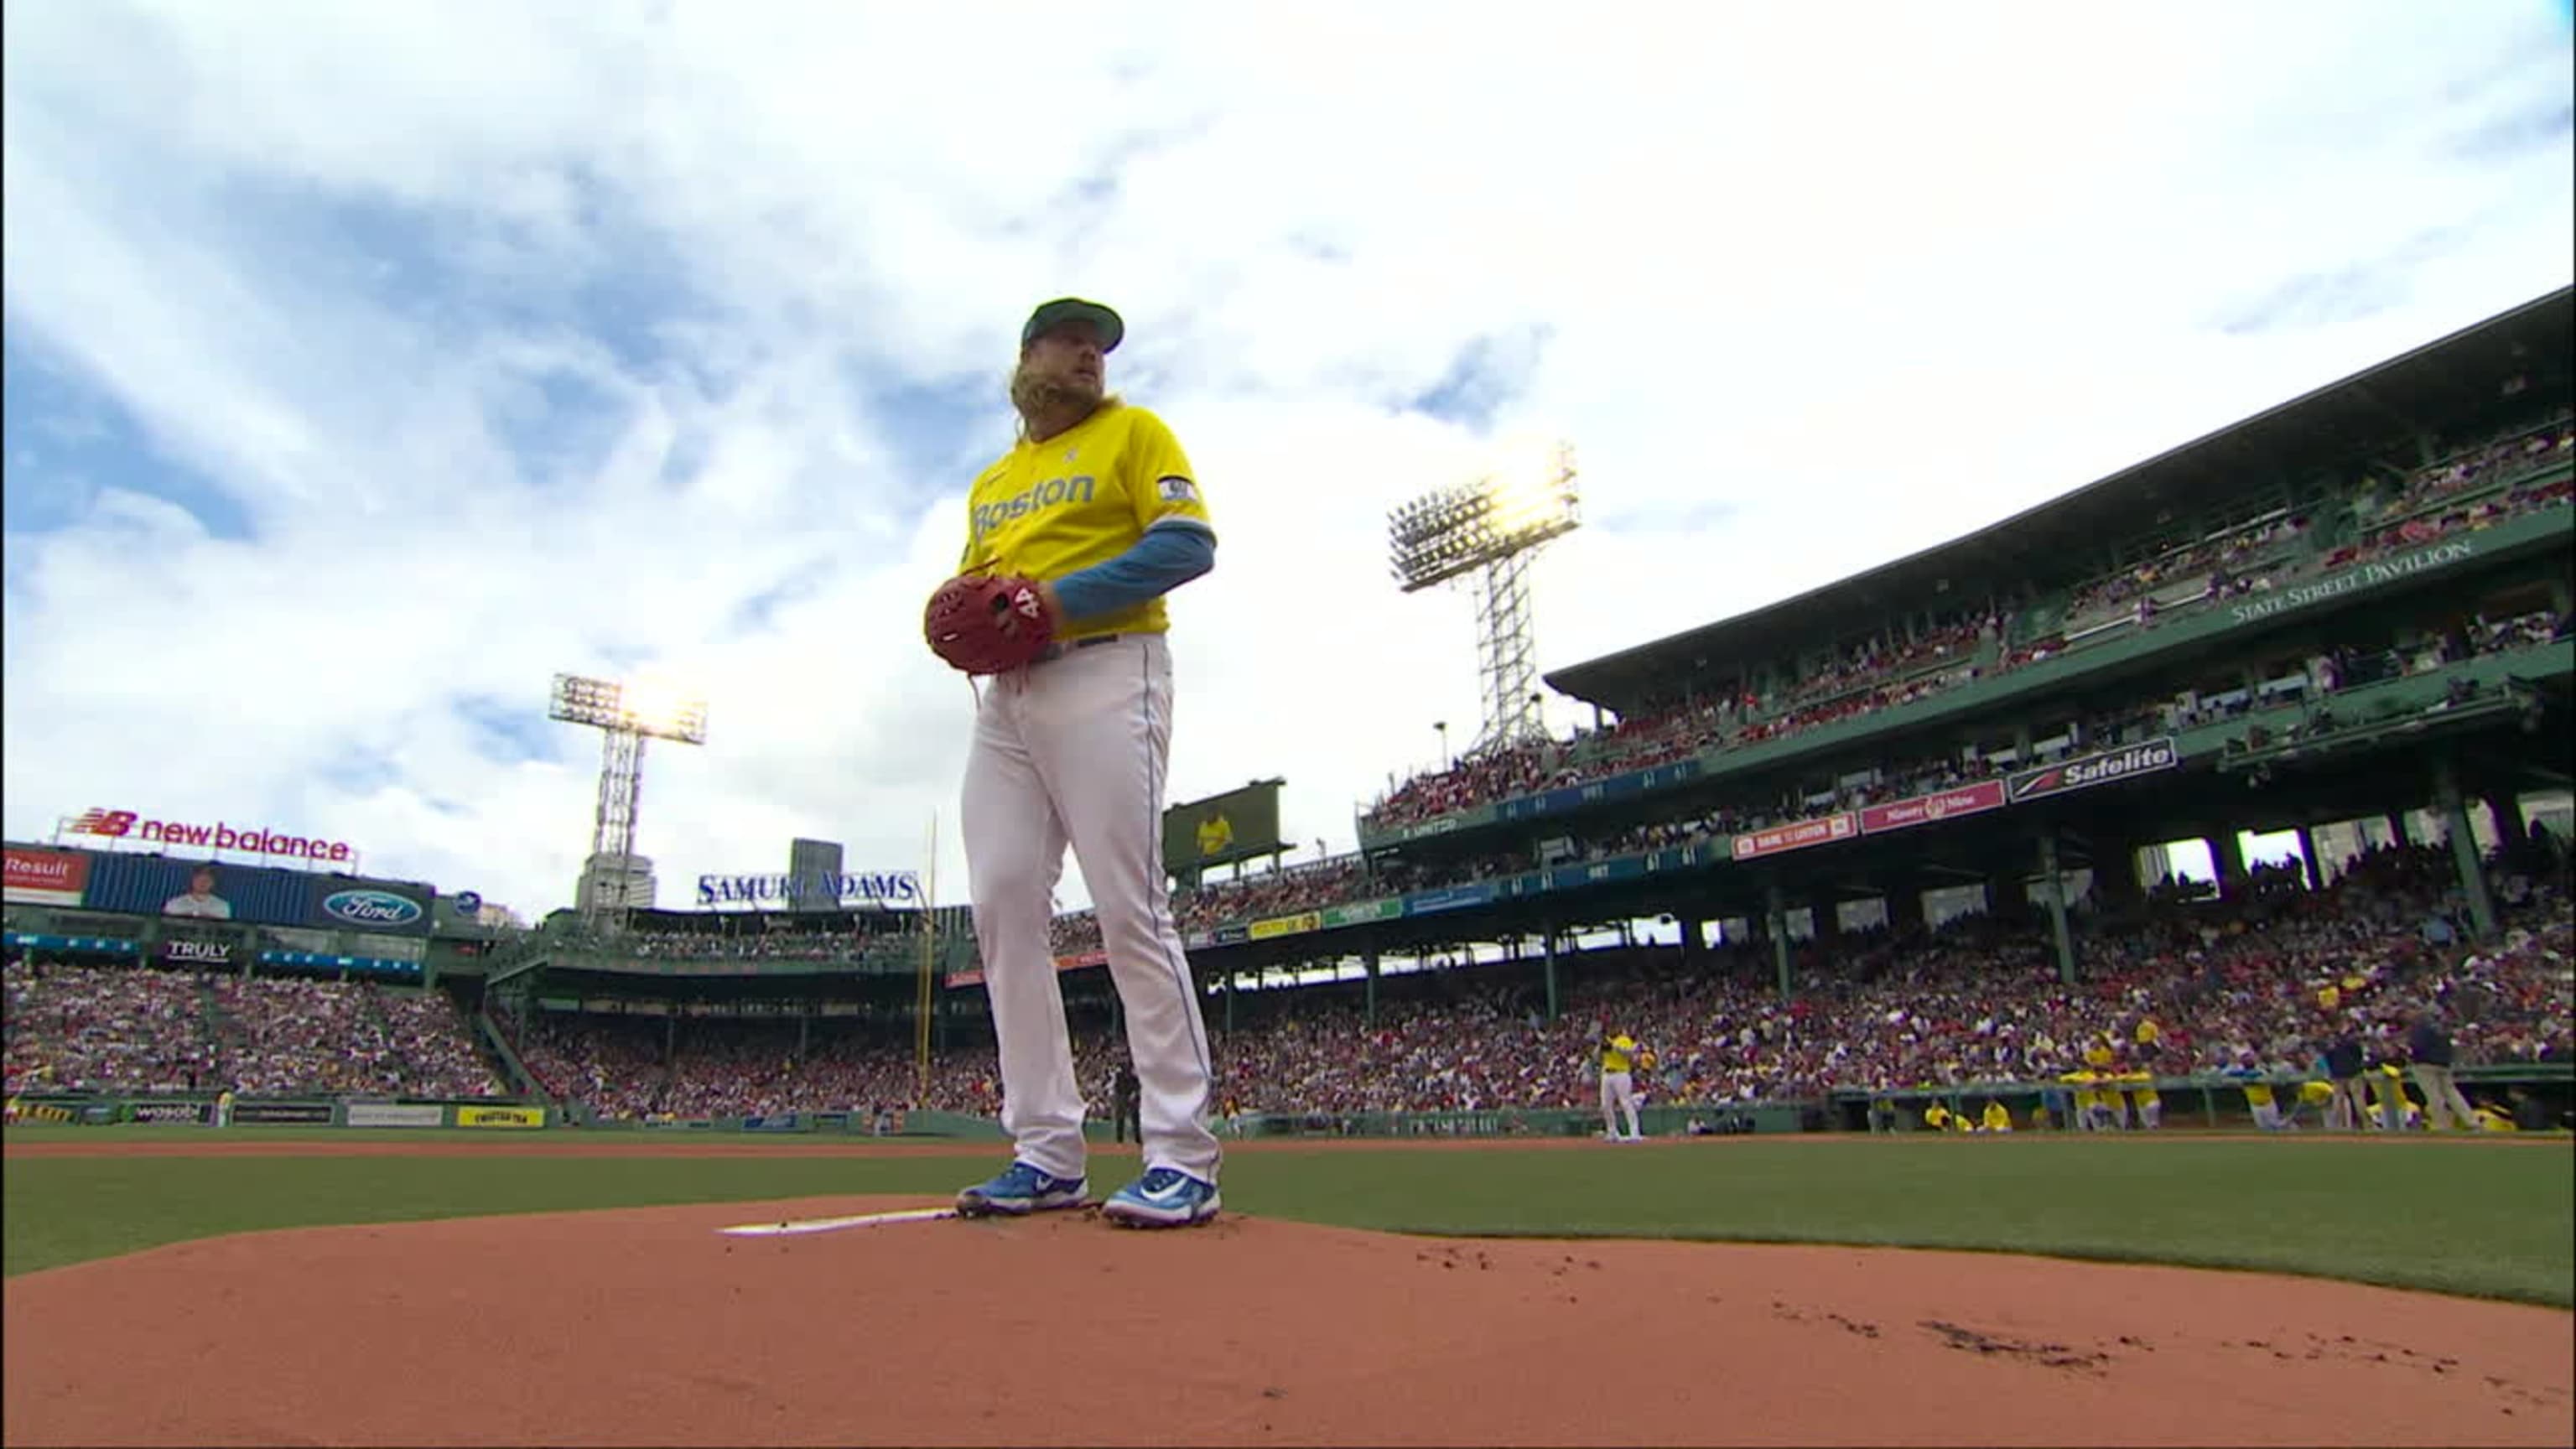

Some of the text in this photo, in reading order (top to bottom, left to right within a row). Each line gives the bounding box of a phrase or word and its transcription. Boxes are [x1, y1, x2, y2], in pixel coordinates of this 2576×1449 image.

[974, 475, 1095, 543] Boston
[2231, 541, 2472, 623] STATE STREET PAVILION
[2065, 747, 2170, 785] Safelite
[142, 820, 210, 845] new
[216, 821, 349, 861] balance
[819, 870, 916, 900] ADAMS
[342, 896, 403, 920] Ford
[169, 940, 231, 958] TRULY
